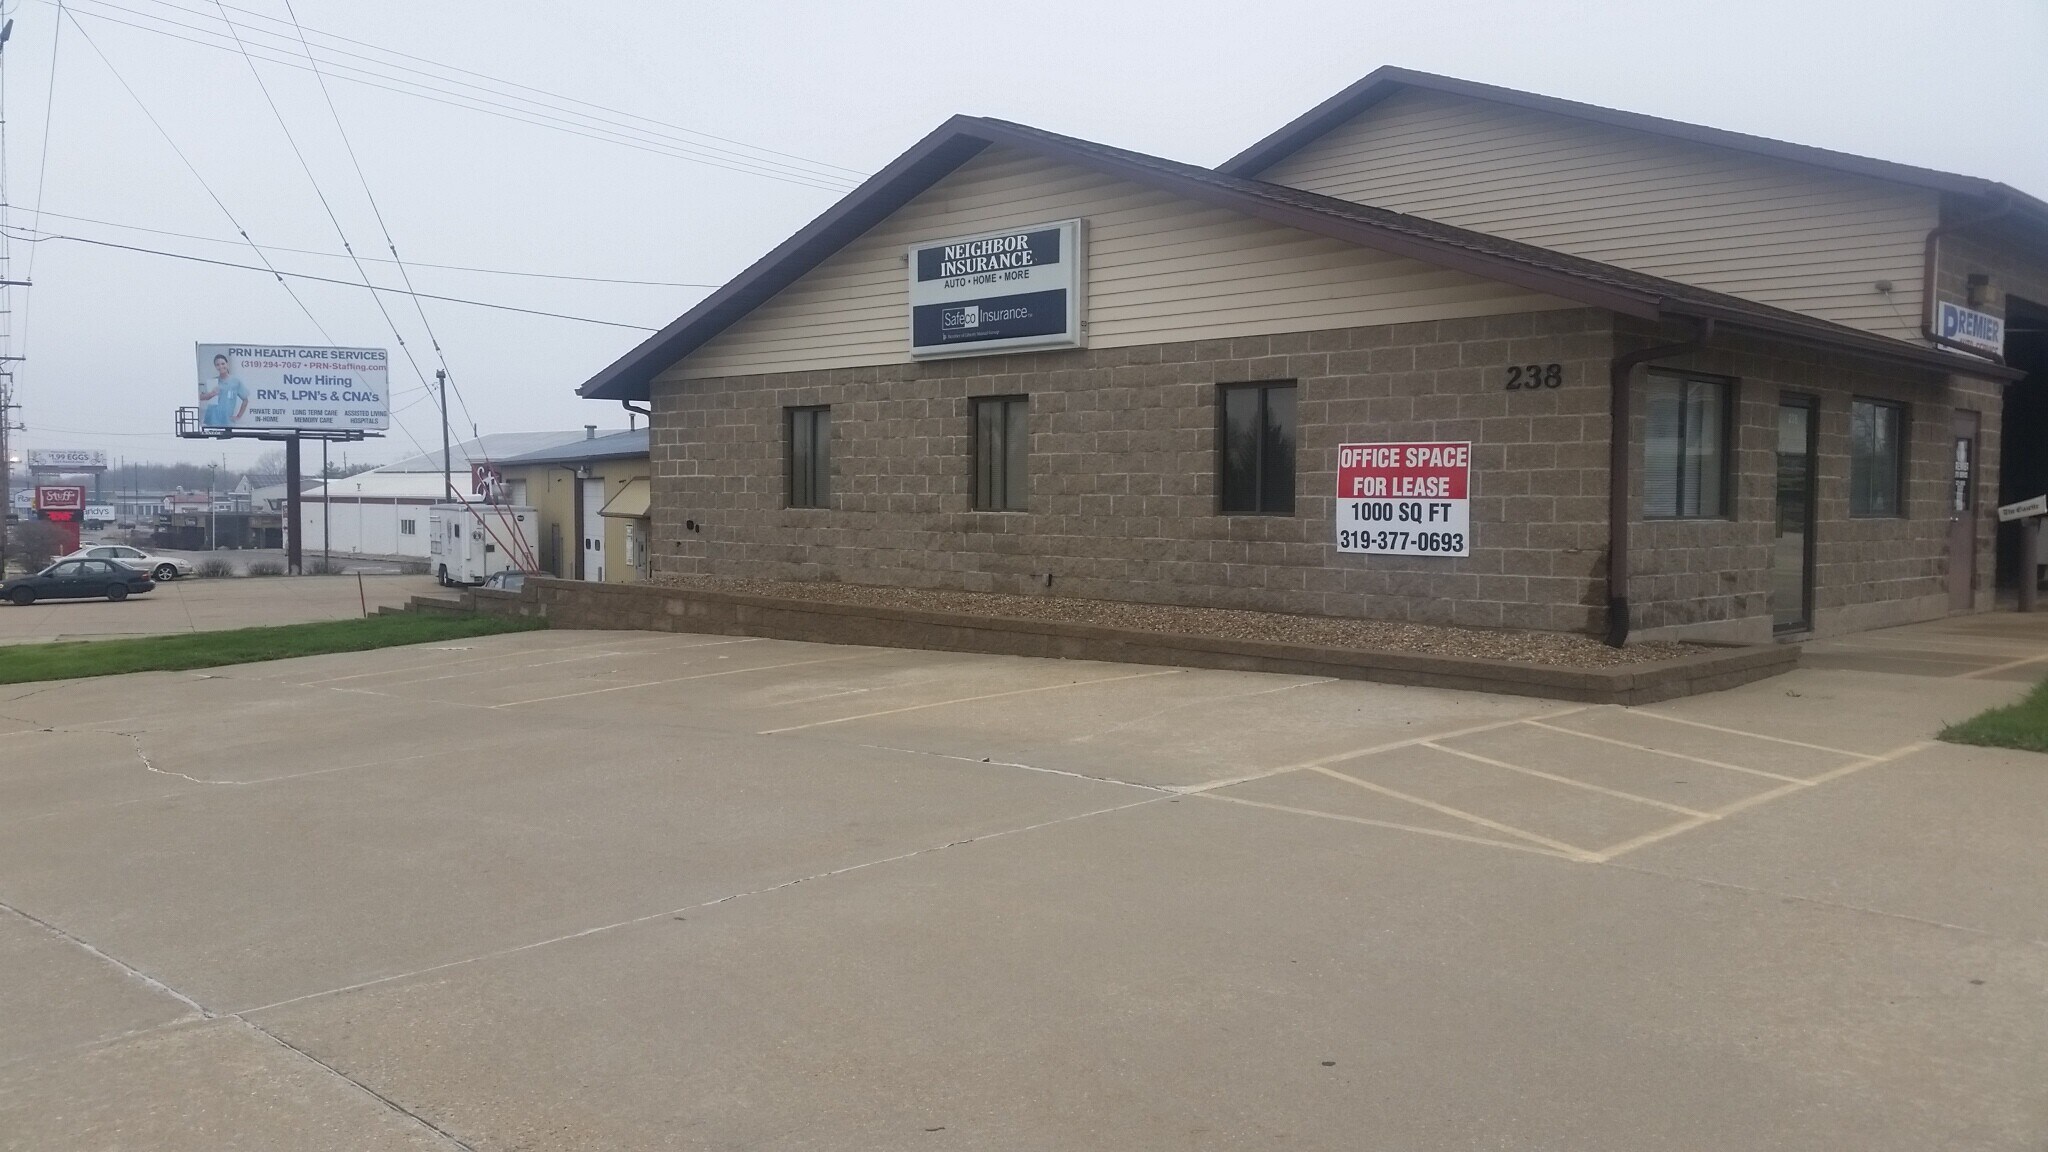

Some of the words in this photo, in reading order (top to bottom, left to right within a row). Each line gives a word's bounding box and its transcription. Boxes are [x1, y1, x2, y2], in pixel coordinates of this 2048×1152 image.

[944, 235, 1028, 260] NEIGHBOR
[940, 250, 1032, 276] INSURANCE
[944, 278, 966, 288] AUTO
[973, 273, 997, 285] HOME
[1004, 269, 1029, 281] MORE
[944, 311, 976, 326] Safeco
[980, 307, 1028, 322] Insurance
[1944, 303, 1999, 343] PREMIER
[228, 348, 252, 357] PRN
[254, 348, 296, 358] HEALTH
[299, 349, 328, 359] CARE
[331, 350, 386, 360] SERVICES
[241, 360, 262, 368] (319)
[309, 362, 387, 372] PRN-Staffing.com
[283, 374, 312, 385] Now
[315, 375, 352, 388] Hiring
[1506, 364, 1562, 390] 238
[292, 390, 327, 401] LPN's
[329, 391, 340, 401] &
[342, 391, 380, 402] CNA's
[67, 453, 89, 461] EGGS
[1341, 448, 1400, 468] OFFICE
[1405, 447, 1467, 468] SPACE
[46, 490, 75, 501] Stuff
[1353, 477, 1387, 496] FOR
[1392, 476, 1450, 497] LEASE
[1351, 502, 1393, 521] 1000
[1398, 502, 1423, 524] SQ
[1429, 503, 1452, 522] FT
[1340, 529, 1464, 552] 319-377-0693
